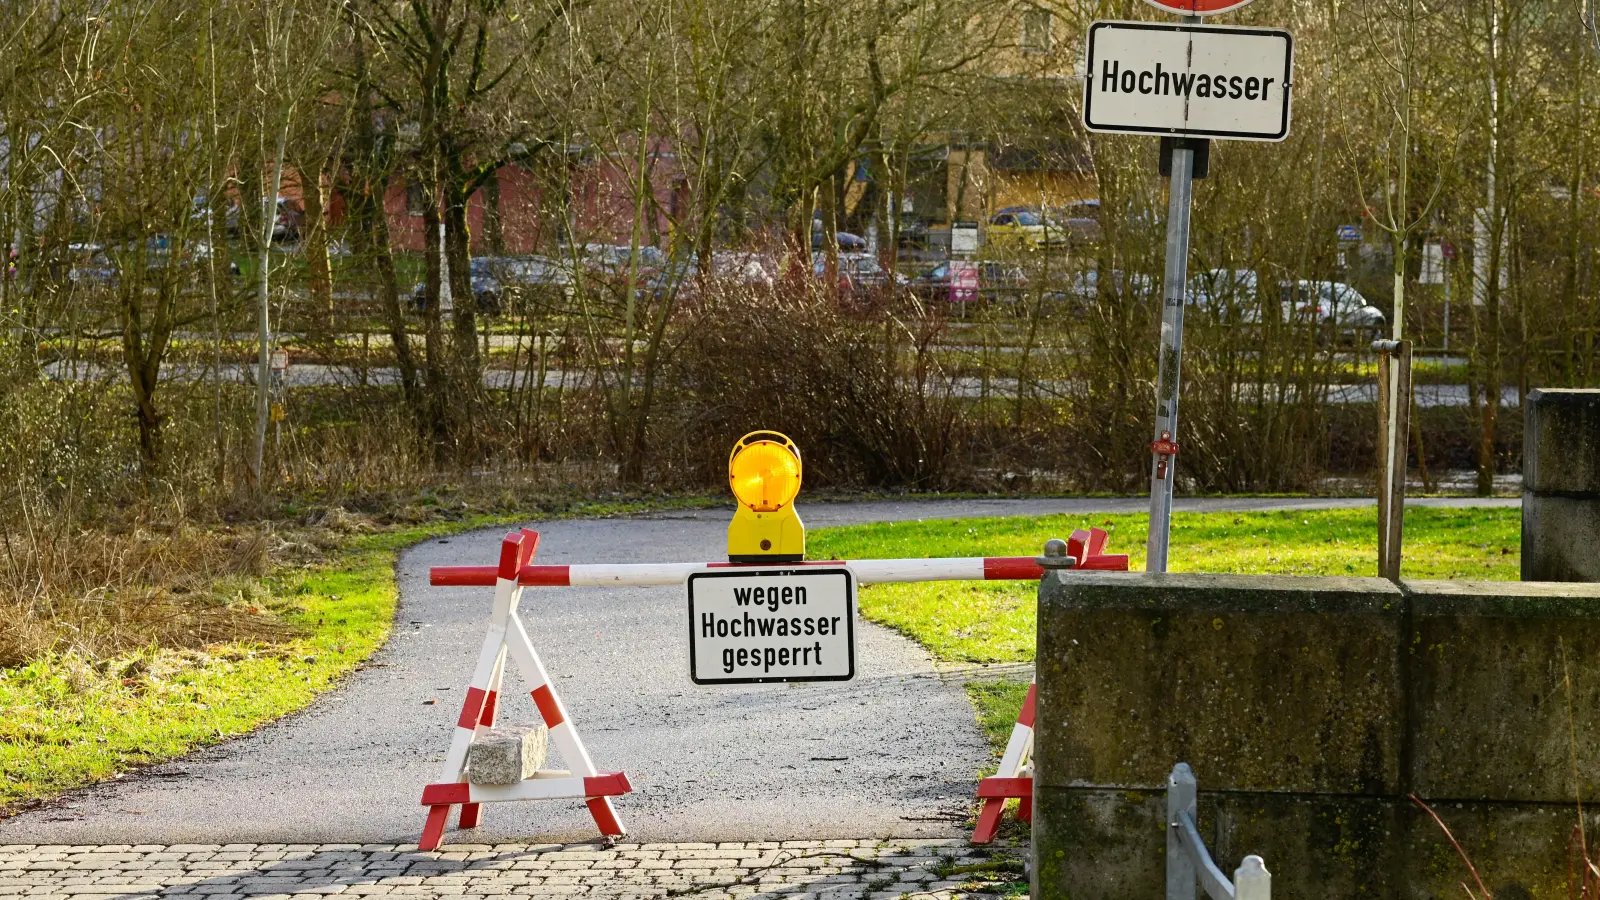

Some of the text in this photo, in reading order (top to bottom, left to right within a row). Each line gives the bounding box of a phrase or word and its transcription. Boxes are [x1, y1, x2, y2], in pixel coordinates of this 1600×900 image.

[1101, 59, 1275, 101] Hochwasser
[733, 585, 807, 612] wegen
[701, 611, 841, 638] Hochwasser
[722, 641, 822, 674] gesperrt
